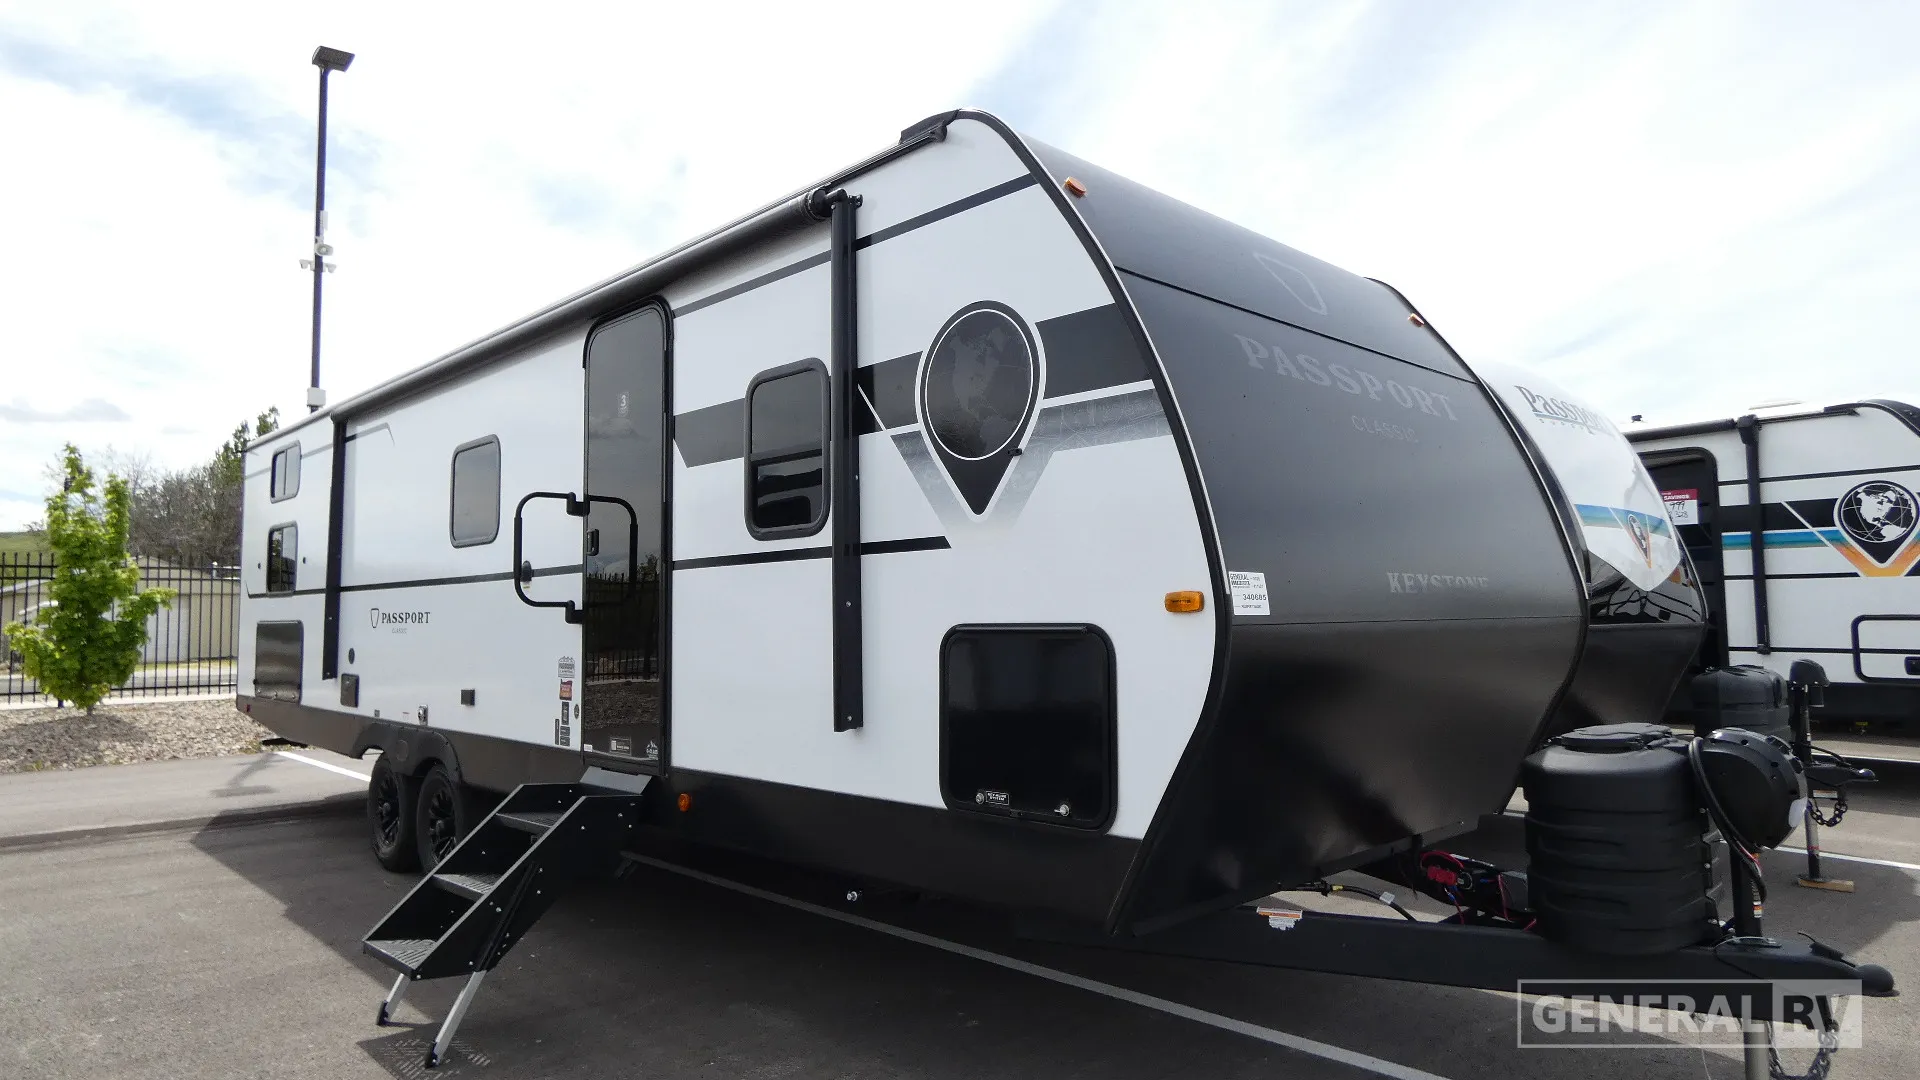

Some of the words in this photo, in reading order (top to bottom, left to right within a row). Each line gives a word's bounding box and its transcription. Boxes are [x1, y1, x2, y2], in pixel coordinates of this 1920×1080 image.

[1234, 333, 1459, 422] PASSPORT
[1351, 413, 1420, 444] CLASSIC
[1387, 571, 1490, 594] KEYSTONE
[381, 612, 430, 624] PASSPORT
